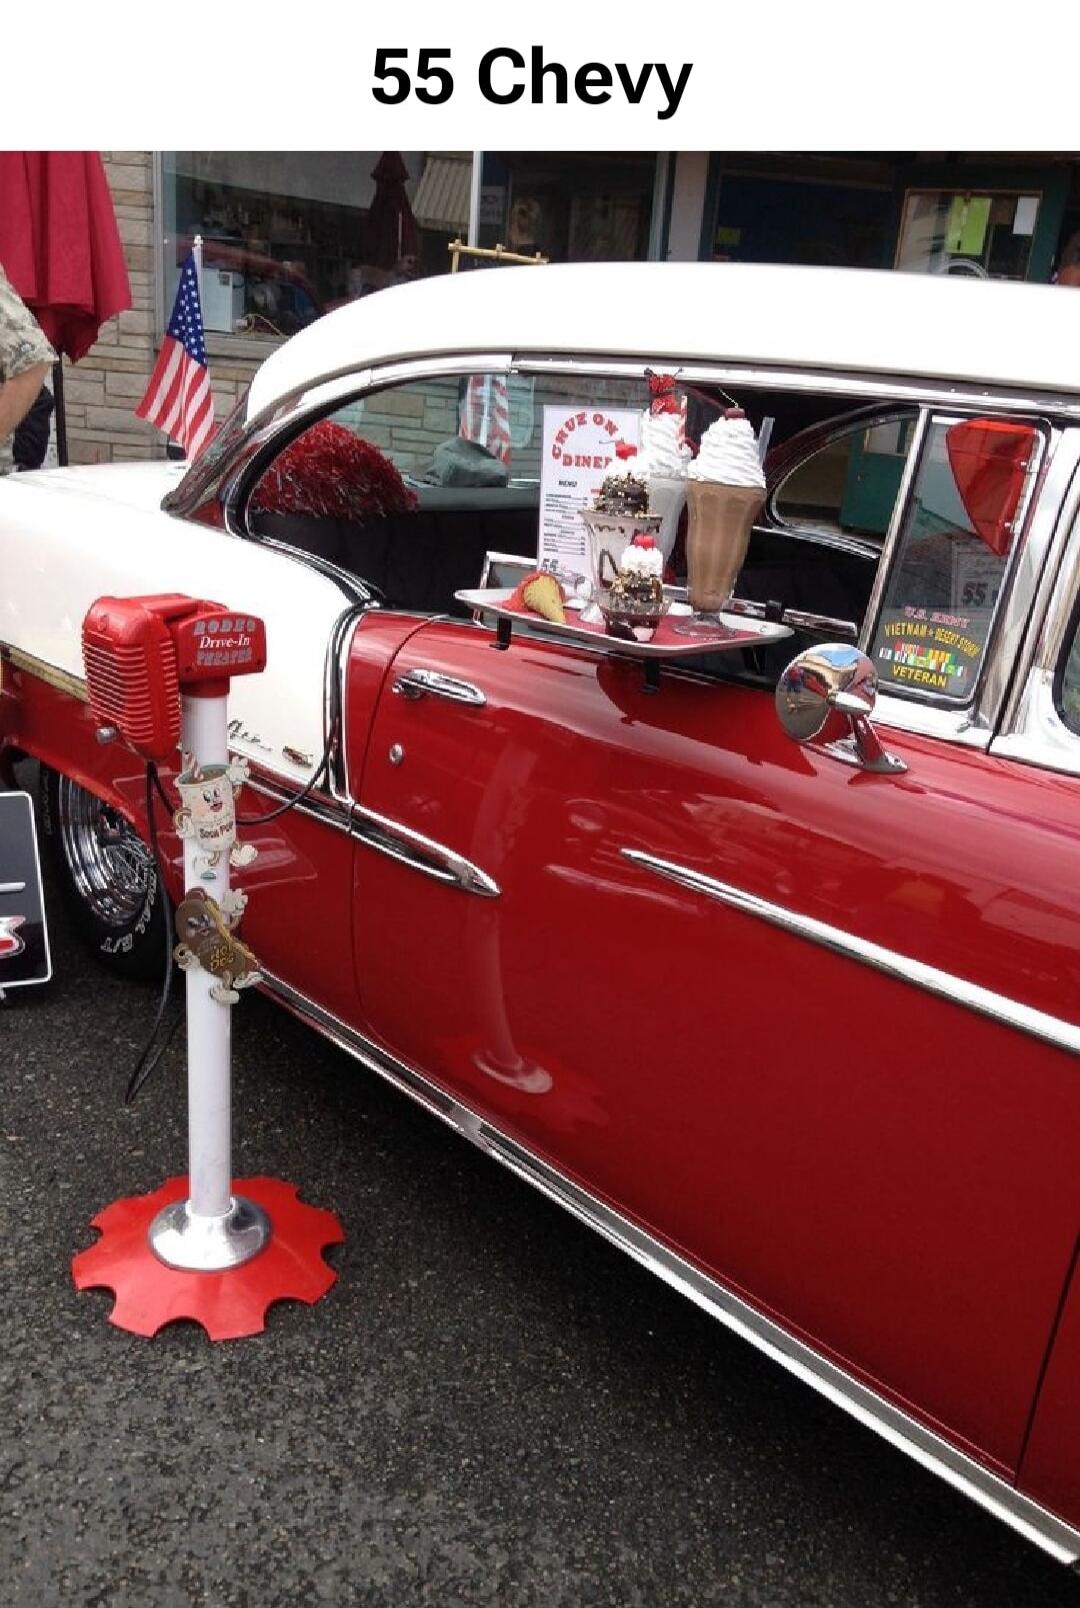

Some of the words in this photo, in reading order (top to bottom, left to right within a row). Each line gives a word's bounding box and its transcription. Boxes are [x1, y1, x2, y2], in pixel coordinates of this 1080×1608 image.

[593, 413, 619, 437] ON
[884, 622, 927, 638] VIETNAM
[199, 633, 251, 649] Drive-In
[892, 664, 948, 687] VETERAN
